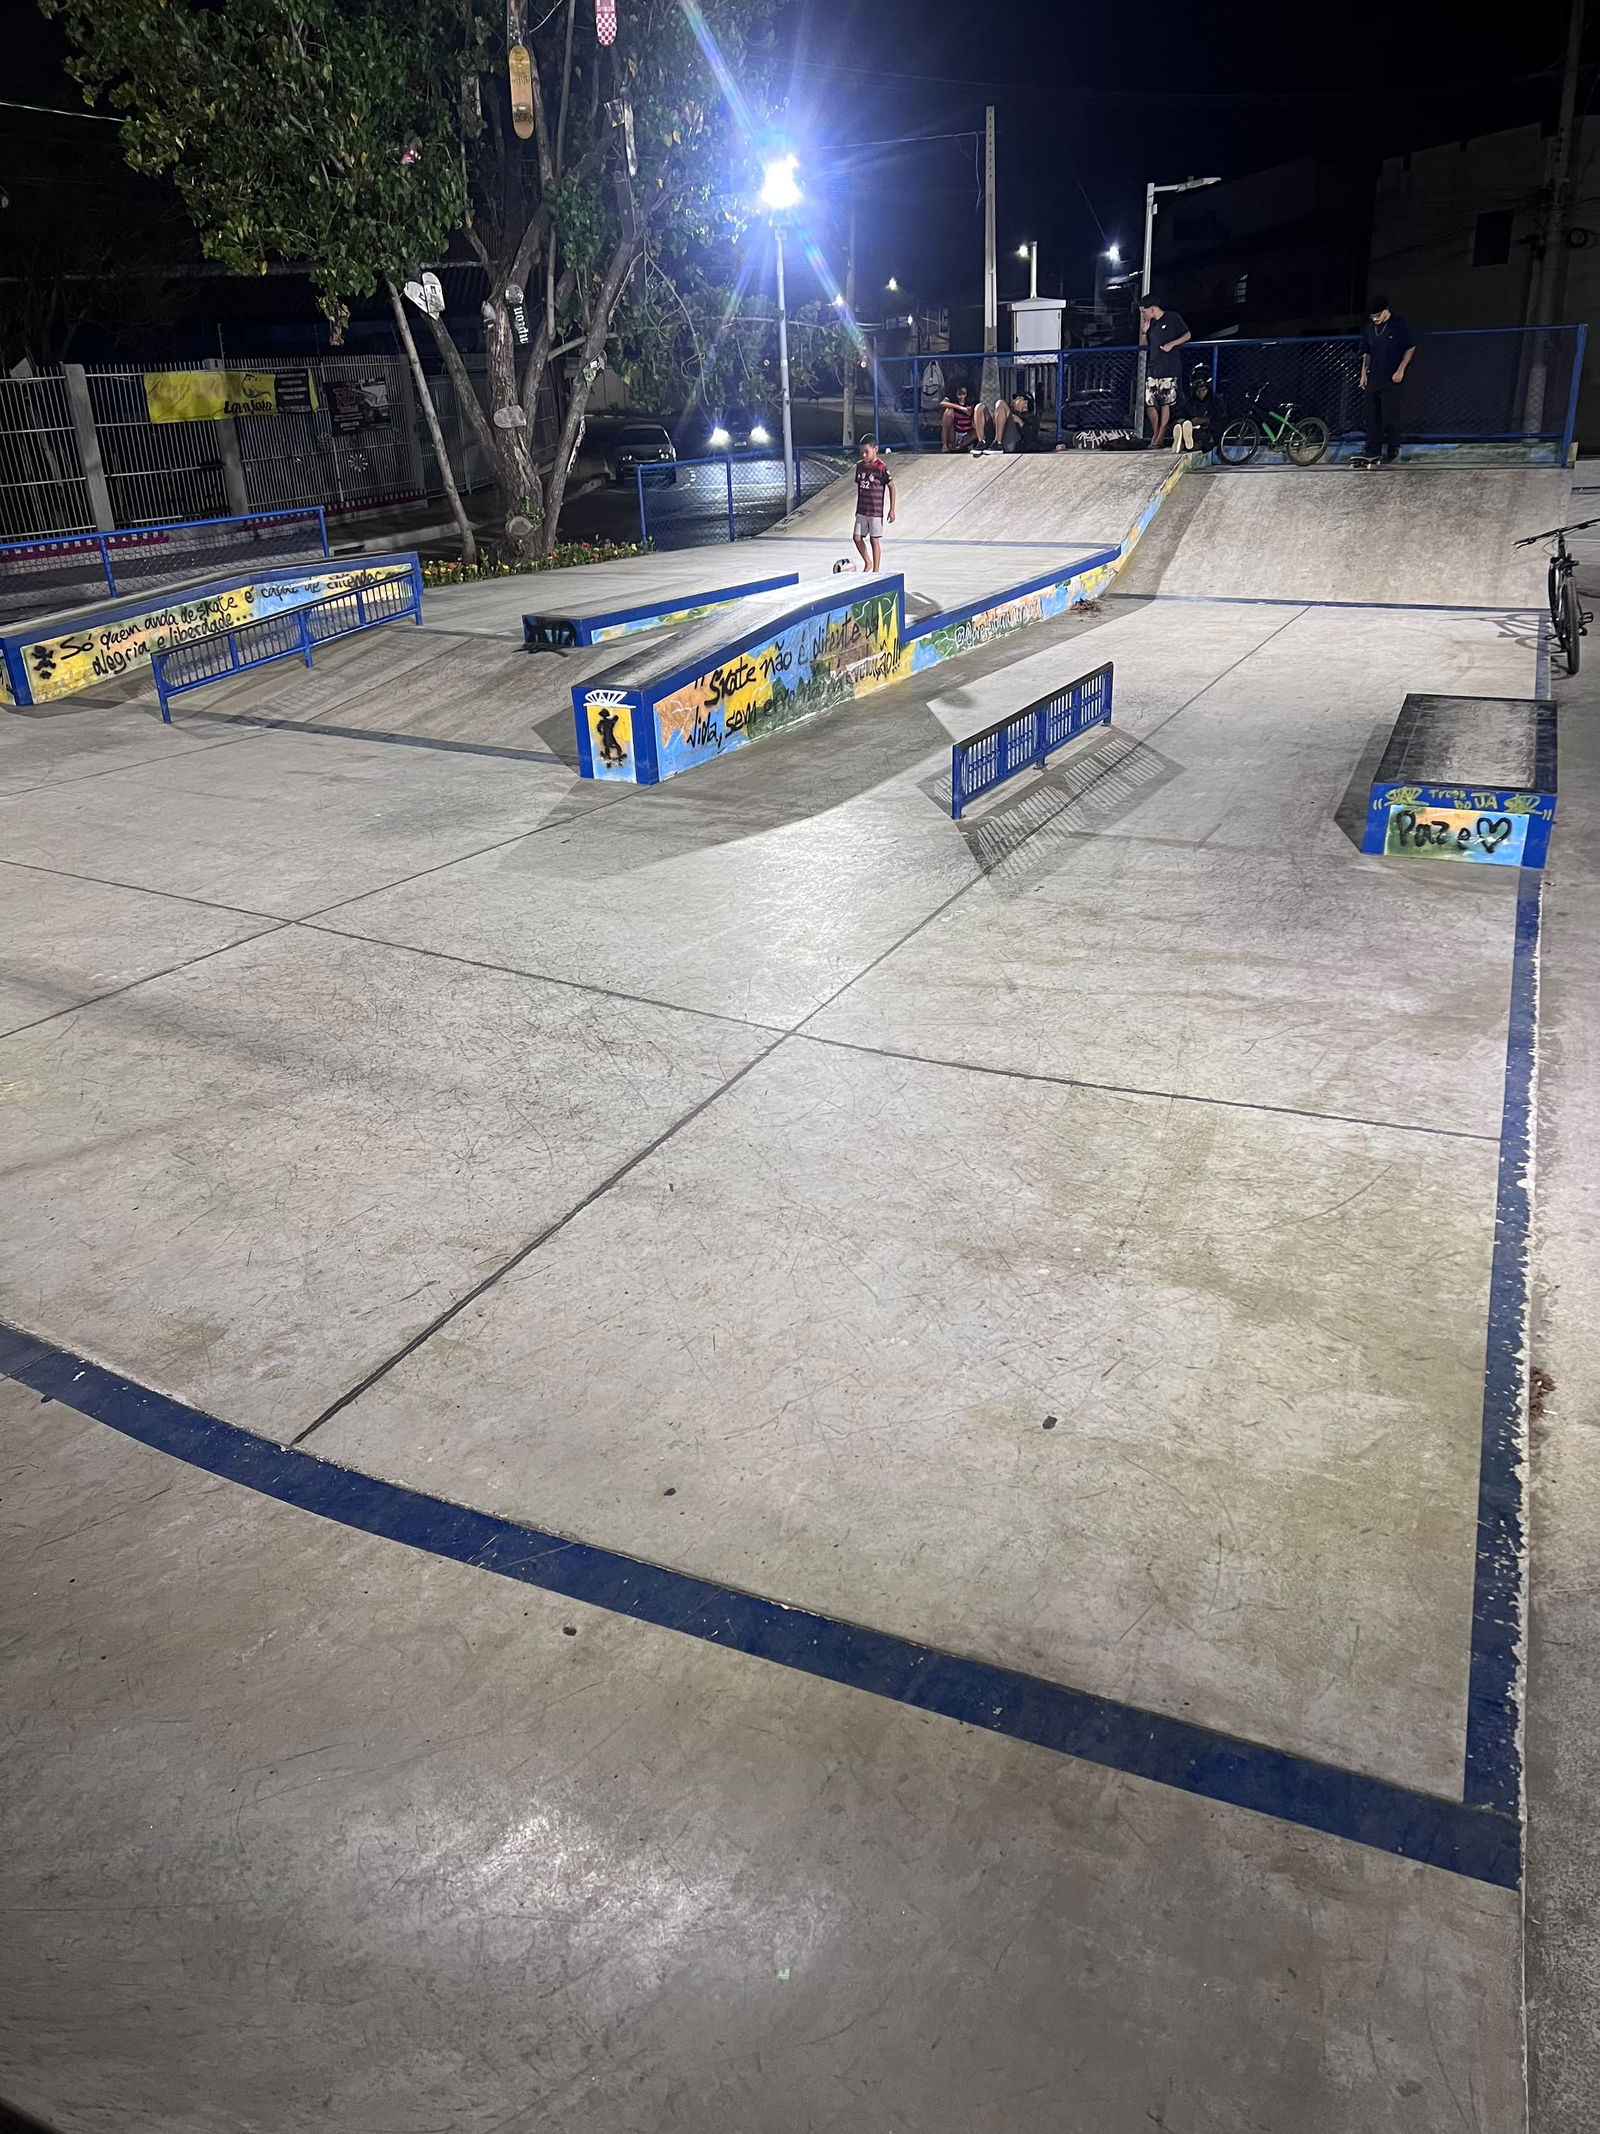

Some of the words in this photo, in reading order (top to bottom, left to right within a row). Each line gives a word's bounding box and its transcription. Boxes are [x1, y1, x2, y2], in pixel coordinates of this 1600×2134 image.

[60, 634, 95, 660] Só
[100, 622, 140, 646] quem
[144, 609, 178, 629] anda
[181, 606, 198, 626] de
[198, 595, 238, 622] skate
[244, 587, 255, 604] é
[92, 640, 150, 676] alegria
[157, 634, 167, 649] e
[760, 639, 793, 679] não
[725, 701, 757, 738] sem
[1397, 810, 1450, 848] Paz
